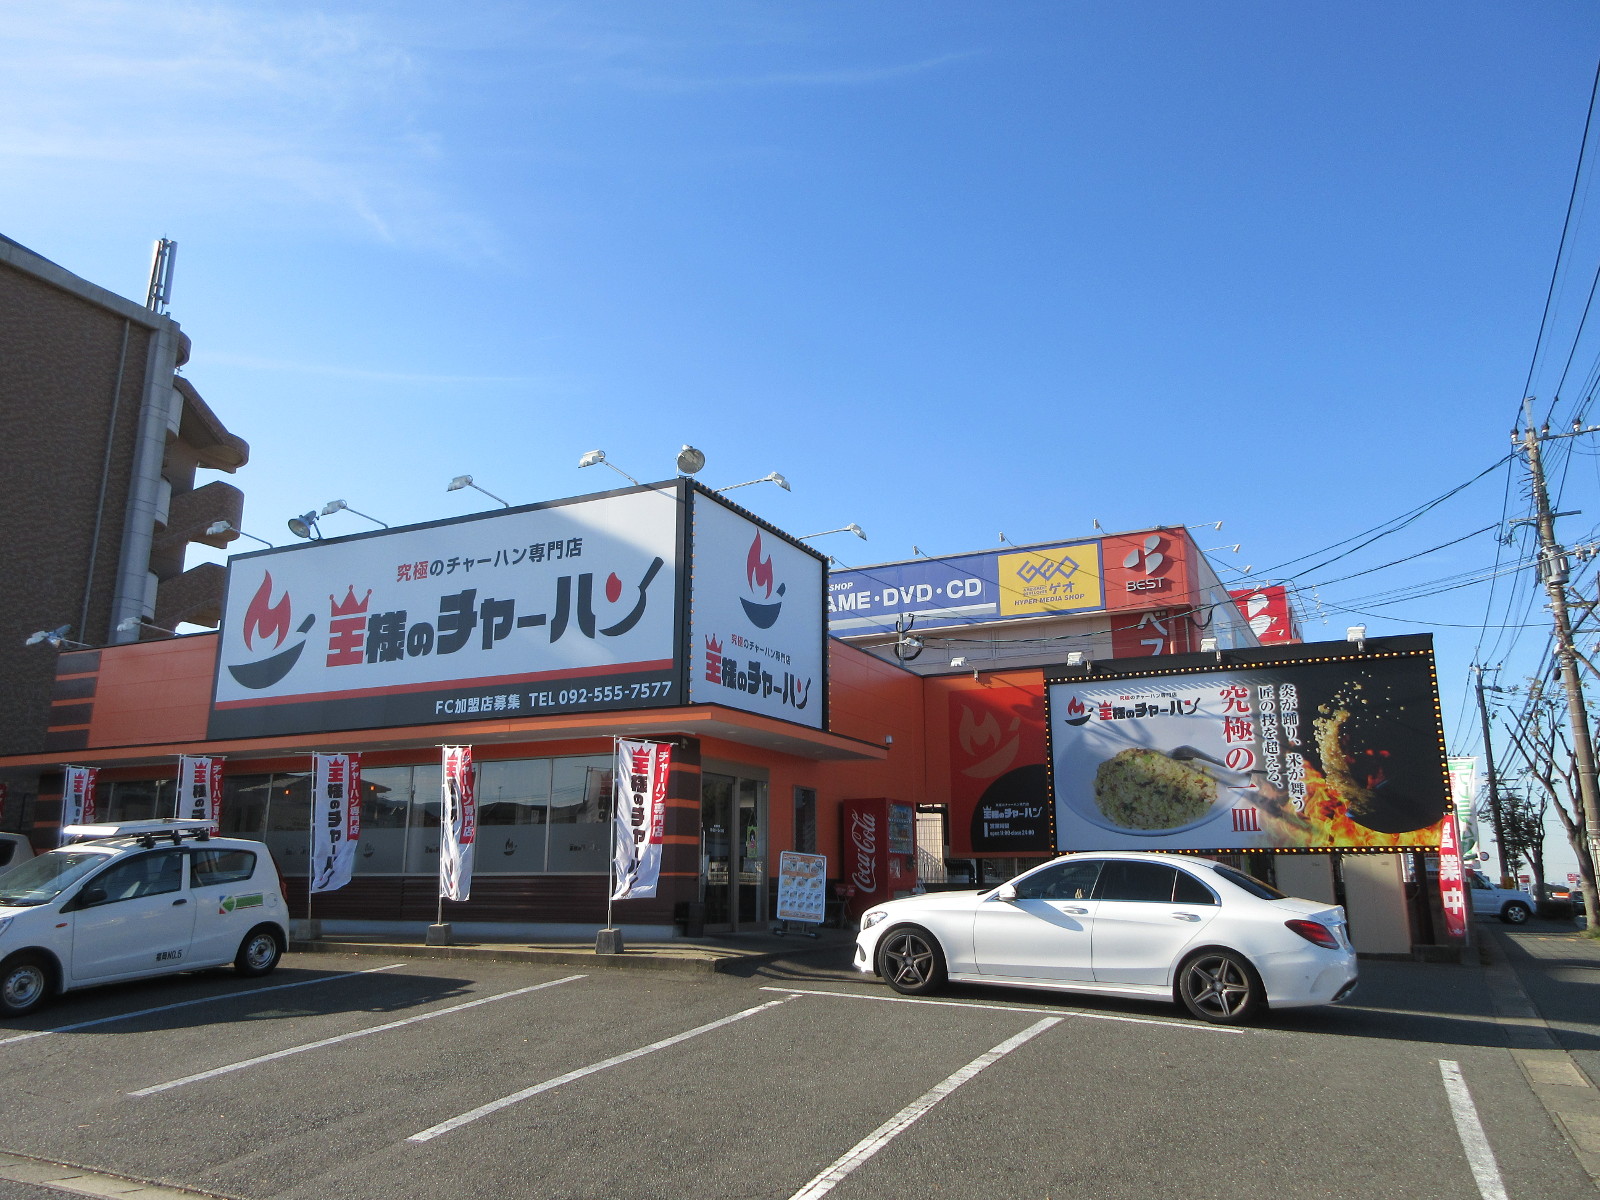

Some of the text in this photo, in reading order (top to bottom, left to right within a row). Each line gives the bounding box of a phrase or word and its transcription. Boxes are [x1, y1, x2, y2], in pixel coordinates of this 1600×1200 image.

[396, 537, 583, 582] 究極のチャーハン専門店
[829, 582, 854, 592] SHOP
[1014, 593, 1085, 606] HYPER MEDIA SHOP
[1049, 581, 1076, 594] ゲオ
[1125, 576, 1165, 592] BEST
[326, 556, 665, 667] 王様のチャーハン
[731, 633, 791, 666] 究極のチャーハン専門店
[435, 681, 672, 714] FC加盟店募集 TEL 092-555-7577
[705, 650, 812, 710] 王様のチャーハン
[1099, 697, 1201, 721] 王様のチャーハン
[1219, 685, 1262, 832] 究極の一皿
[1258, 685, 1283, 789] 匠の技を超える、
[349, 761, 360, 835] チャーハン専門店
[652, 751, 669, 838] チャーハン専門店
[851, 809, 877, 893] Coca-Cola
